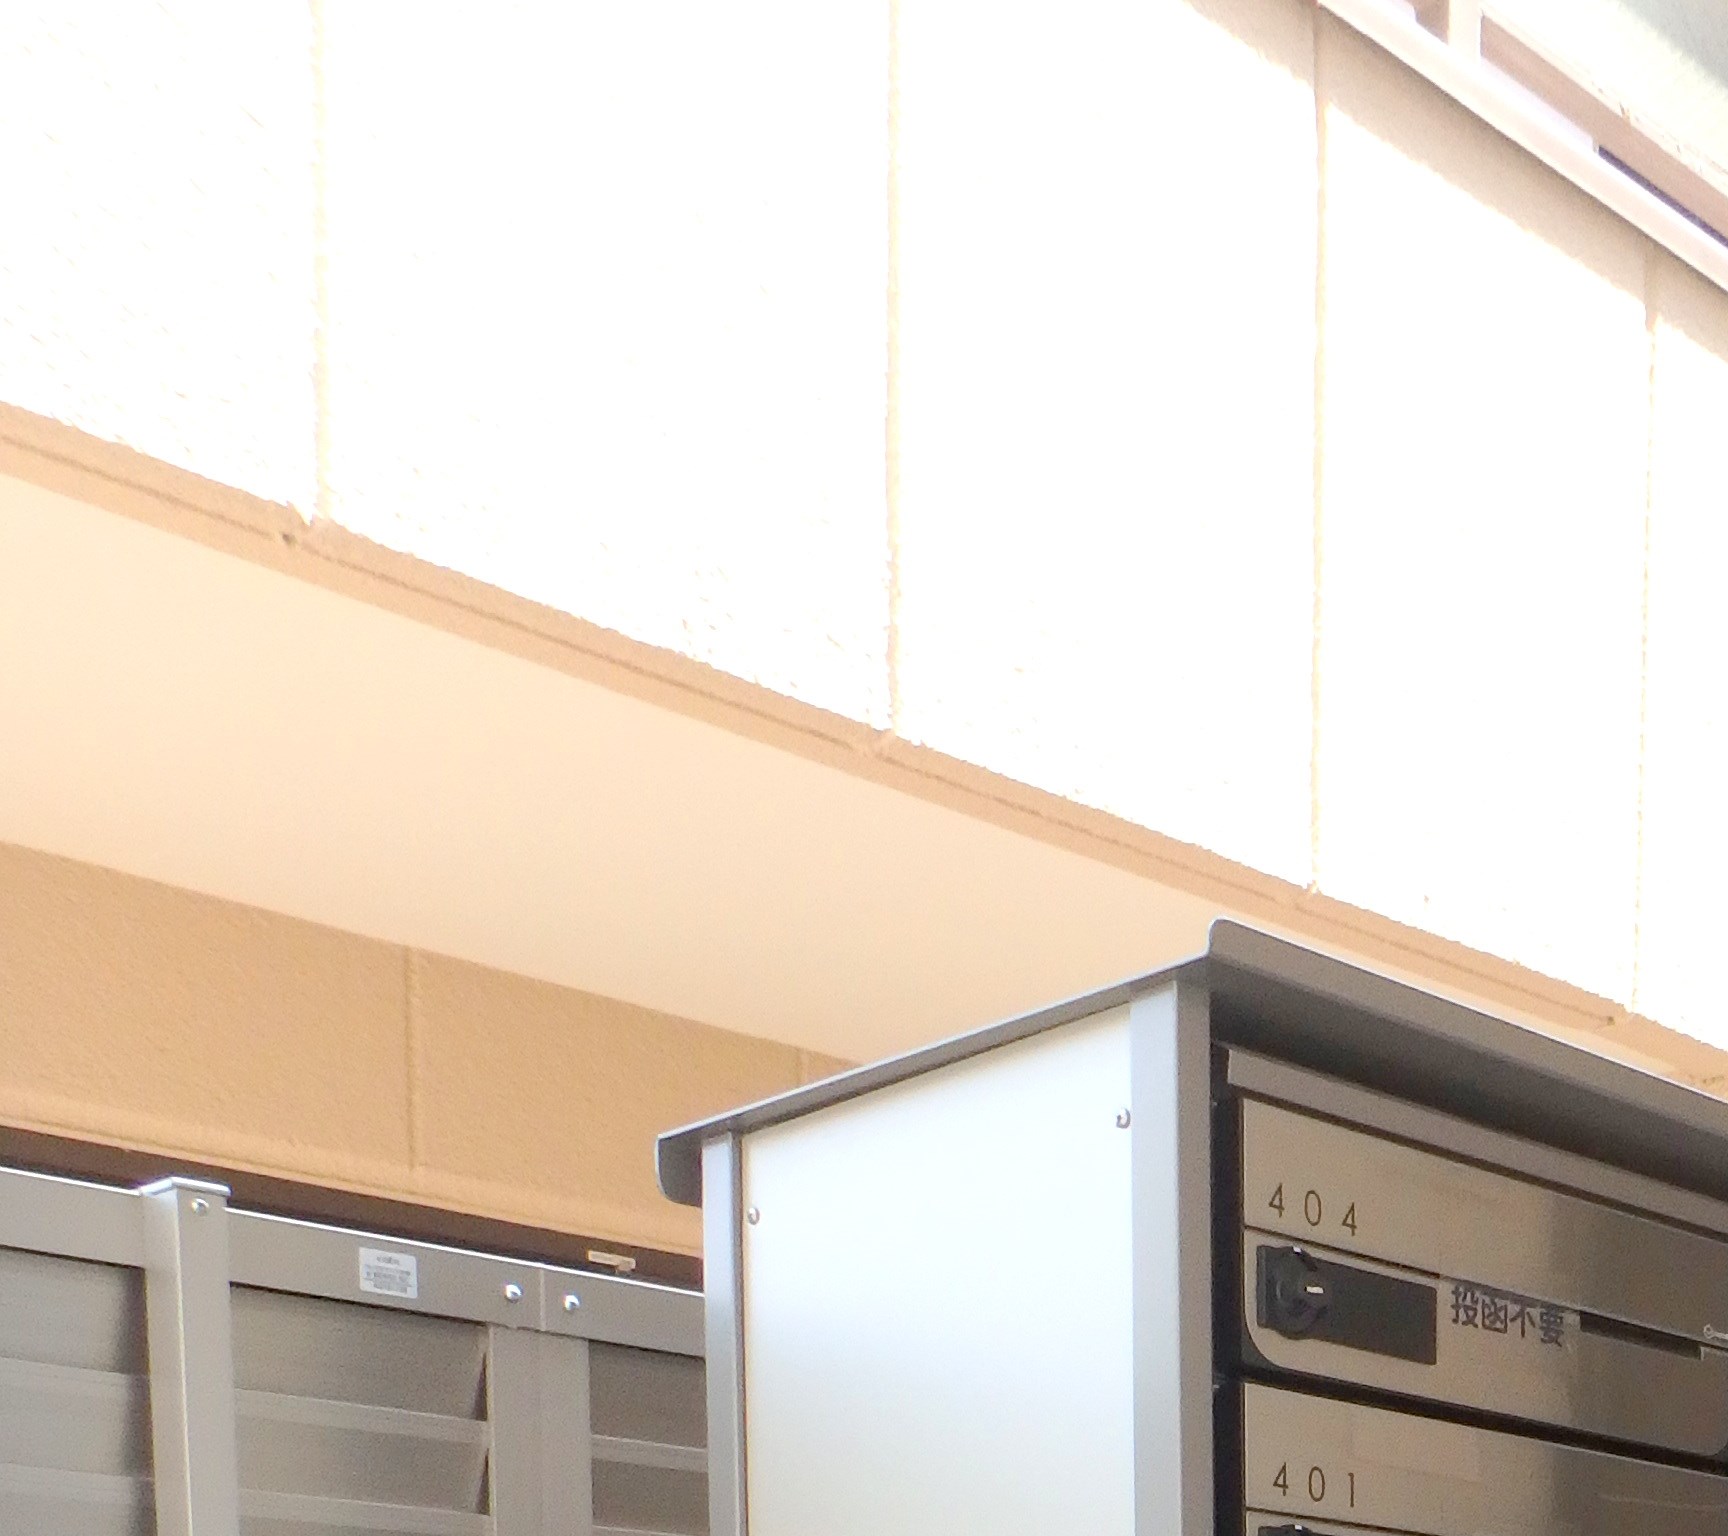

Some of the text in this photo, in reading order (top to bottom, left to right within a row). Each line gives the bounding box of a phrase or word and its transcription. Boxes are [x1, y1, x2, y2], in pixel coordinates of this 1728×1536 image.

[1269, 1183, 1357, 1236] 404
[1450, 1285, 1564, 1347] 投函不要
[1273, 1462, 1355, 1508] 401
